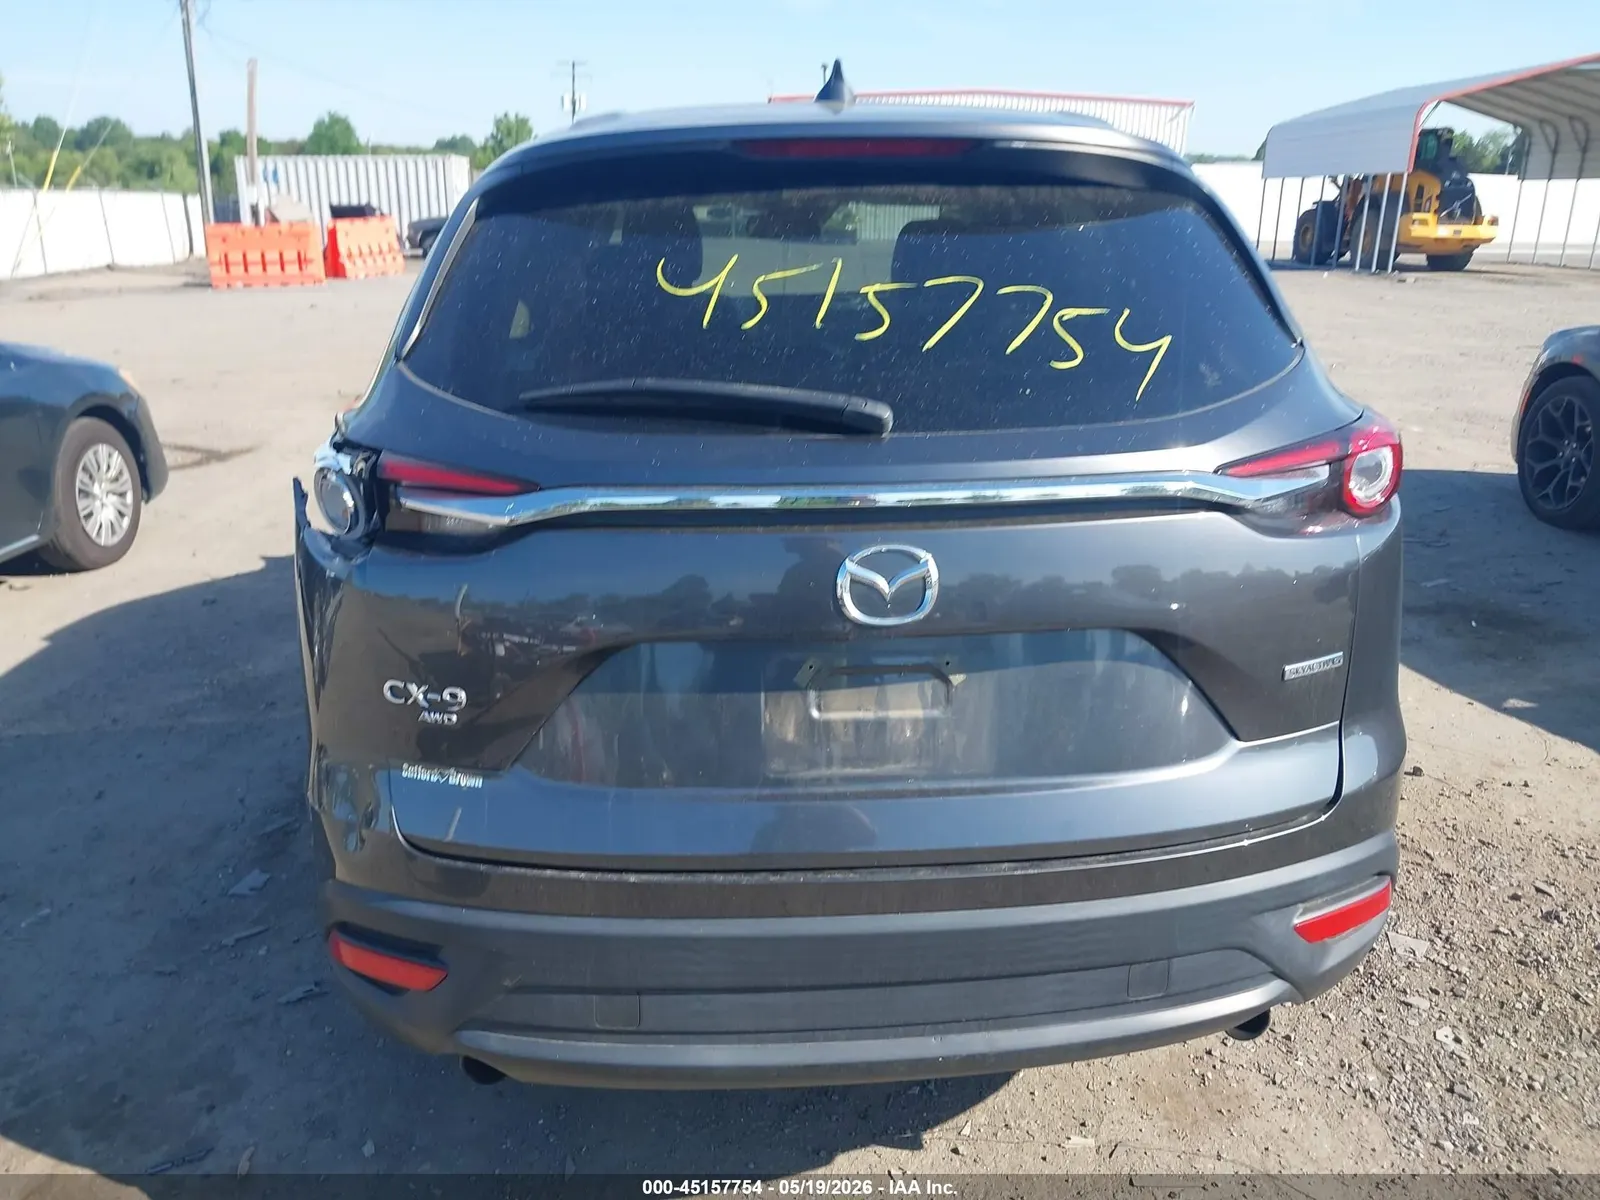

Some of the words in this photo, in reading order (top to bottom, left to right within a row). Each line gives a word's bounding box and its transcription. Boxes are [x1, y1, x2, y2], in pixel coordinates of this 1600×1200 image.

[656, 253, 1172, 401] 45157754
[382, 678, 467, 712] CX-9
[418, 710, 458, 726] AWD
